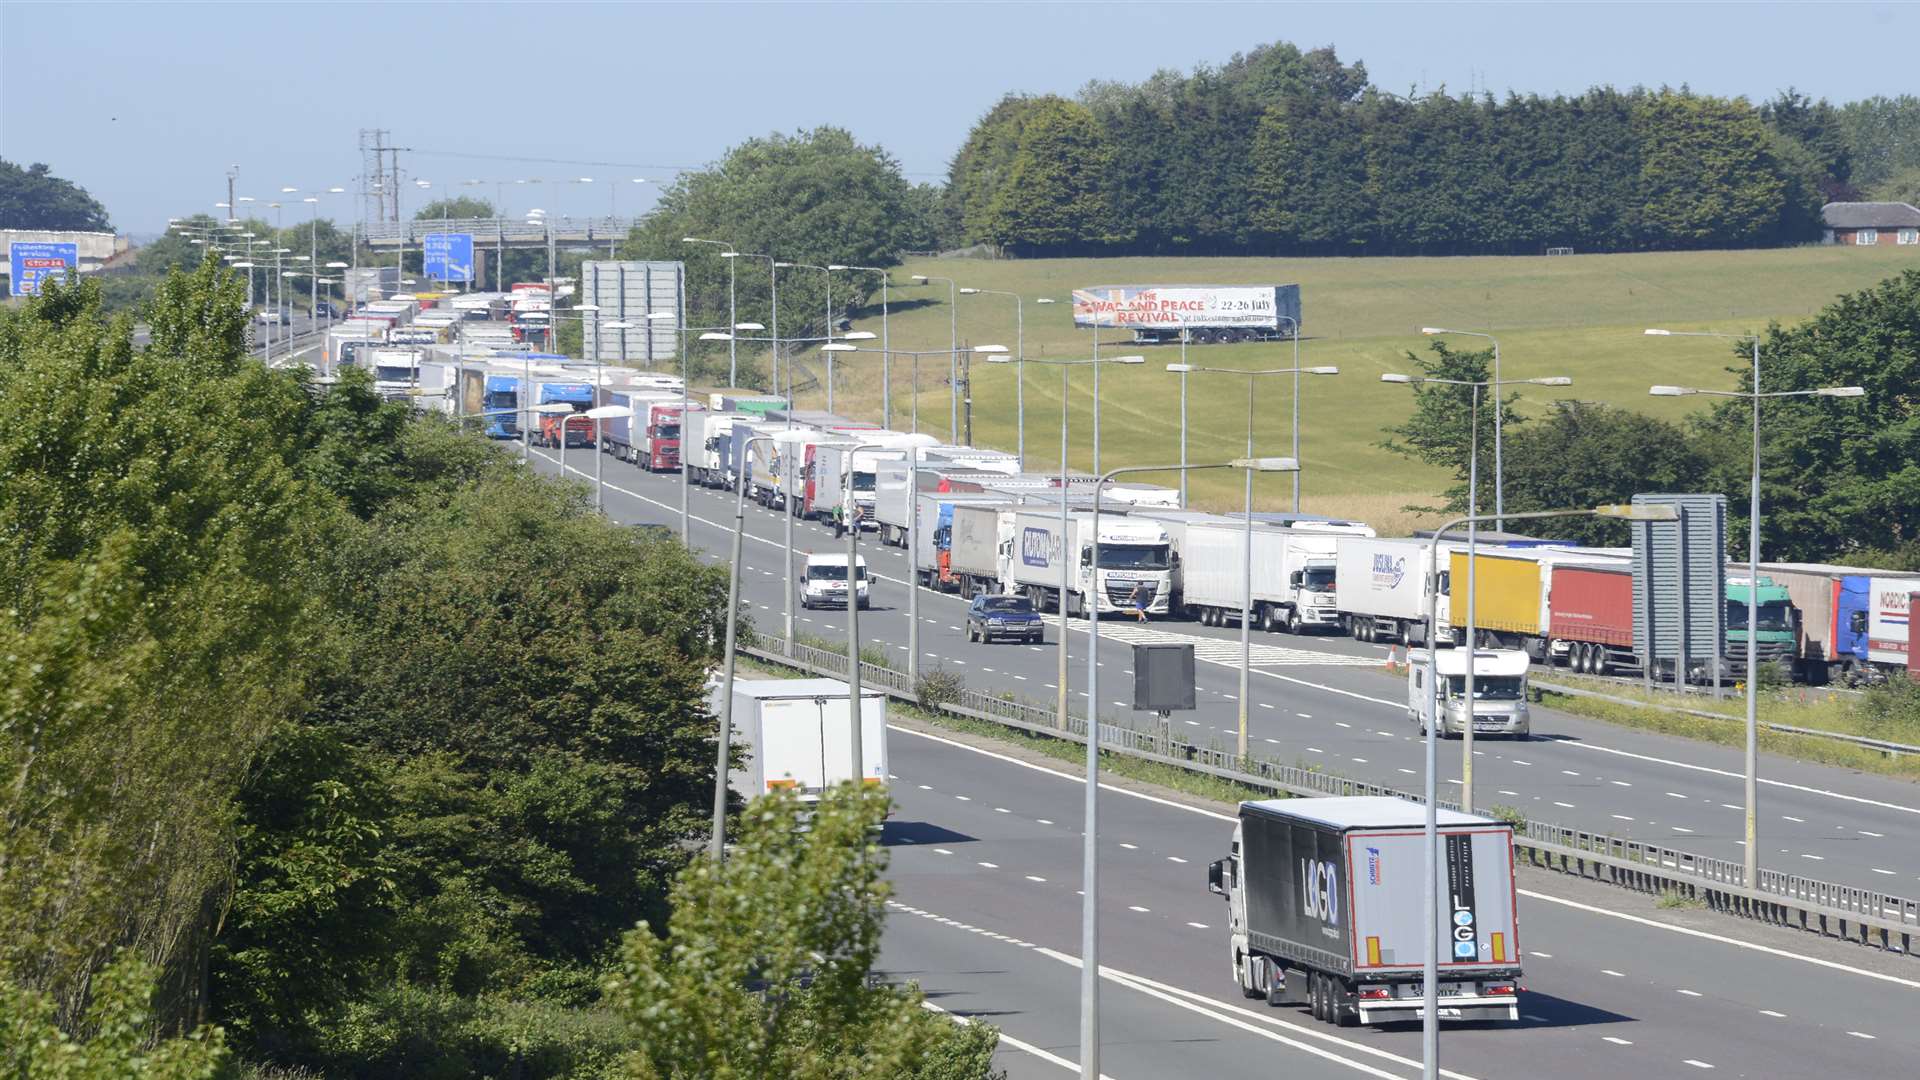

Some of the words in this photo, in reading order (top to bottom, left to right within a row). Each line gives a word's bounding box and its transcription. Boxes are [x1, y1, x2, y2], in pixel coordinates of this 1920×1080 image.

[1136, 292, 1156, 300] THE
[1161, 300, 1205, 311] PEACE
[1119, 312, 1179, 322] REVIVAL
[1880, 592, 1905, 608] NORDIC
[1302, 858, 1338, 924] LOGO
